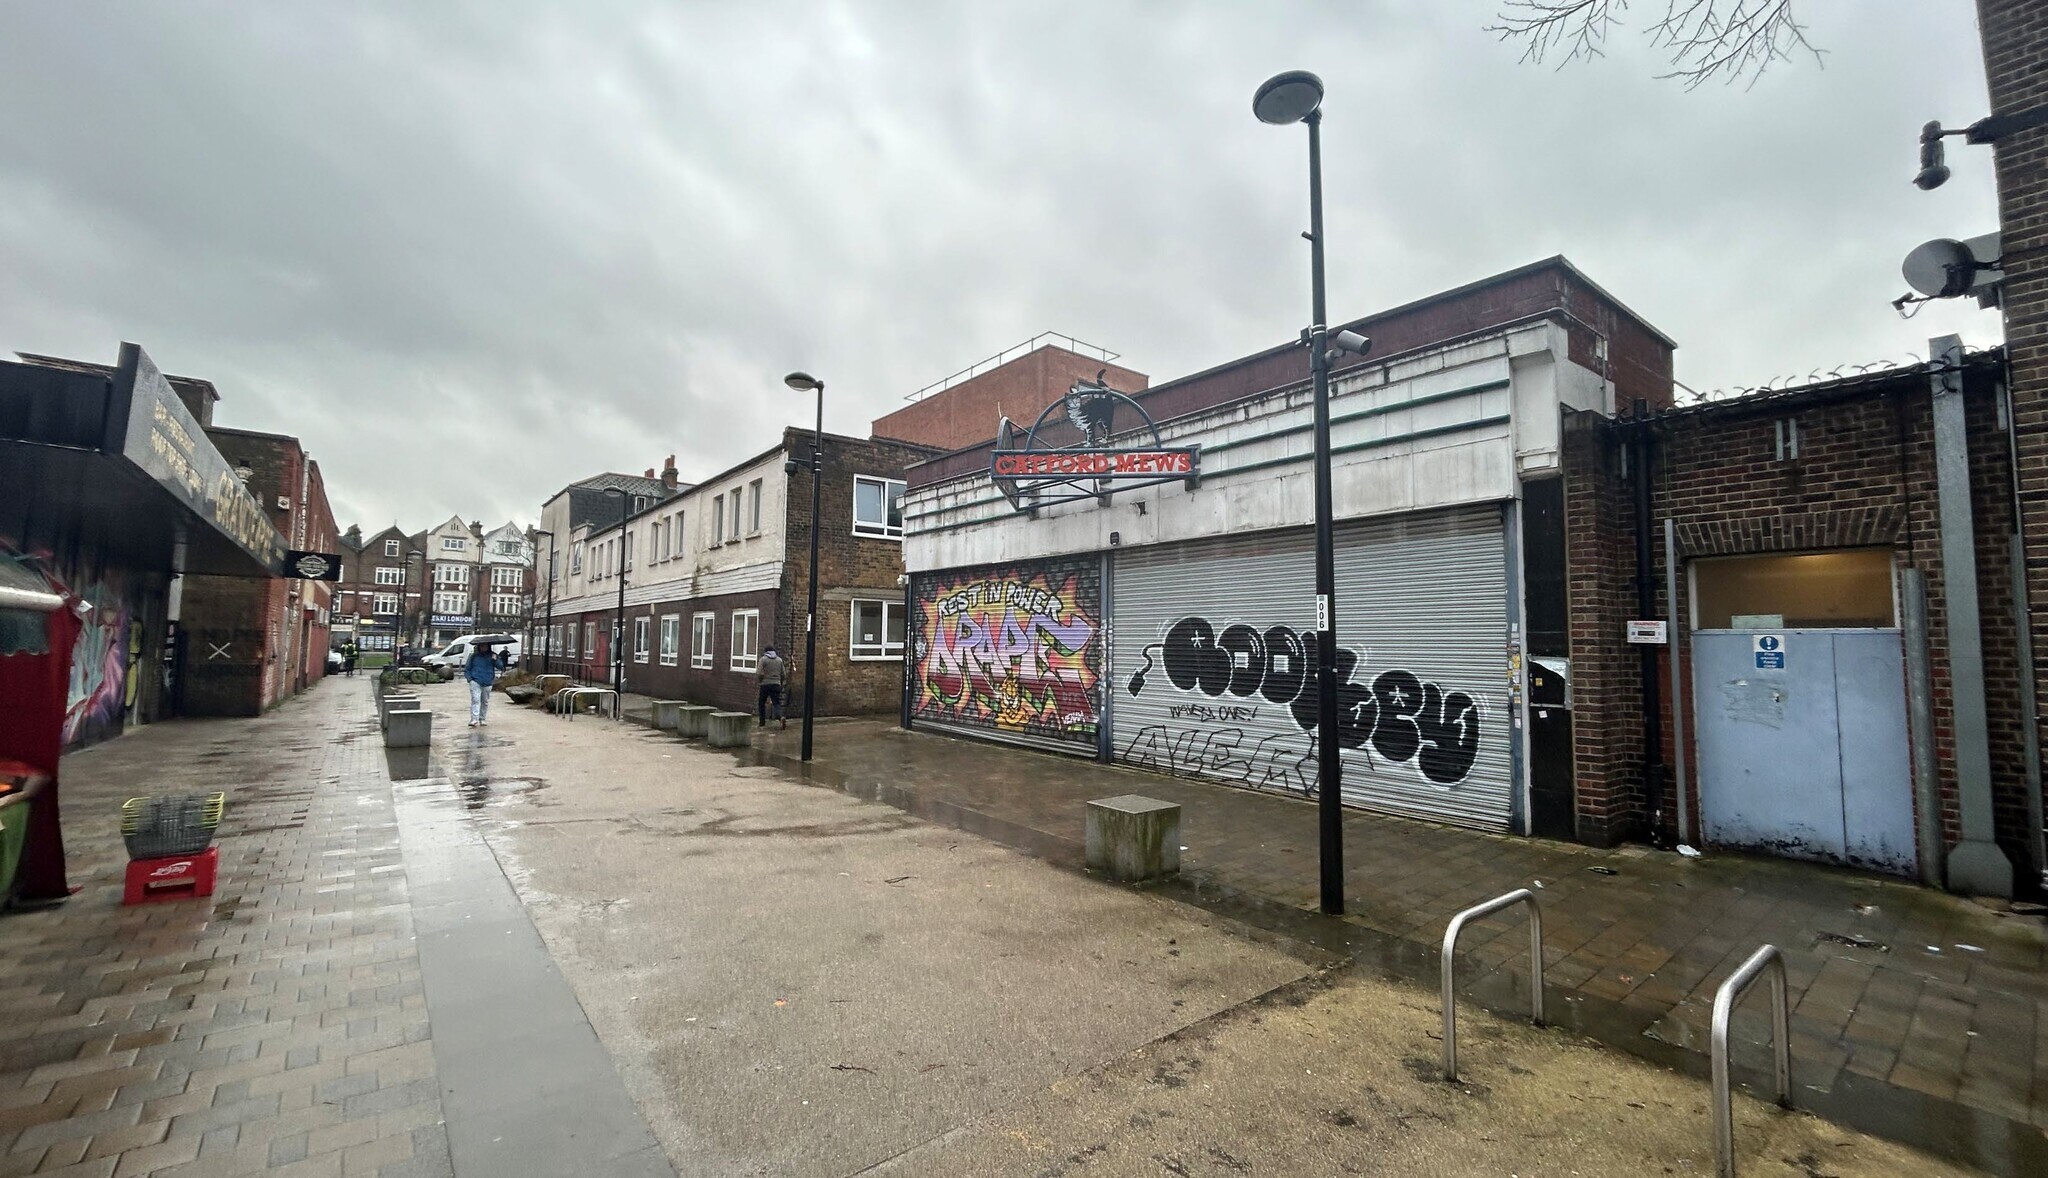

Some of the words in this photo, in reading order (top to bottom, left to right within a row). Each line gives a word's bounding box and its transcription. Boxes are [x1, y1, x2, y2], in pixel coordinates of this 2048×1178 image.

[995, 454, 1109, 475] CATFORD
[1114, 452, 1192, 473] MEWS
[937, 582, 982, 617] REST
[1005, 582, 1063, 622] POWER
